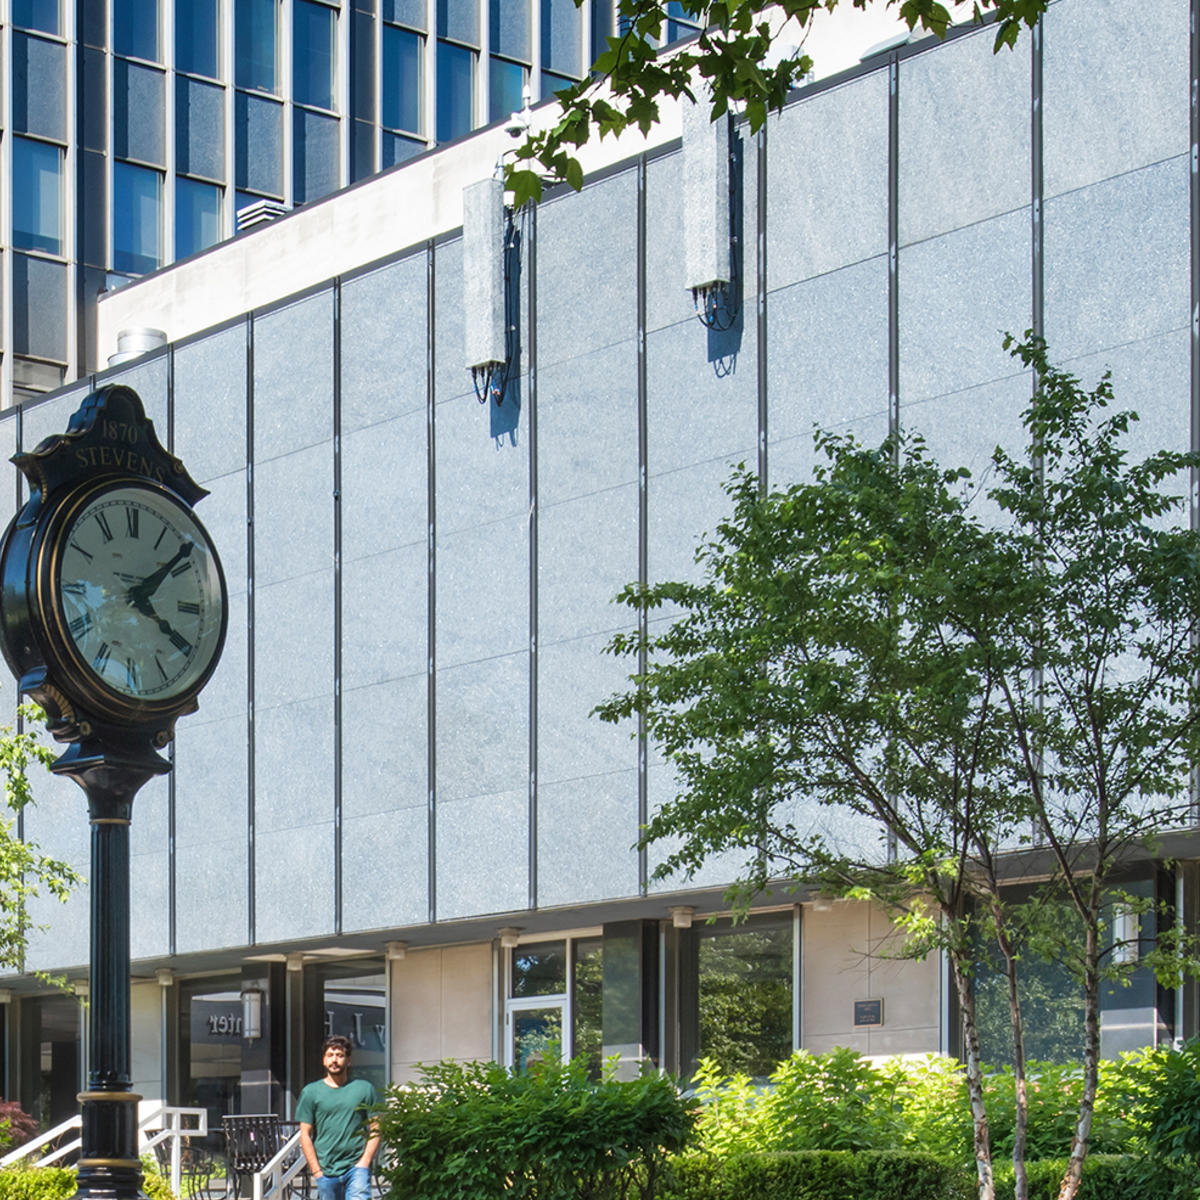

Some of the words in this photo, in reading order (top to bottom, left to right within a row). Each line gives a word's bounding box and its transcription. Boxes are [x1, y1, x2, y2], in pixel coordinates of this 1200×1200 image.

[102, 419, 138, 444] 1870
[76, 445, 166, 483] STEVENS
[94, 510, 114, 544] XI
[125, 507, 139, 539] XII
[70, 536, 94, 565] X
[170, 561, 192, 578] II
[177, 600, 200, 615] III
